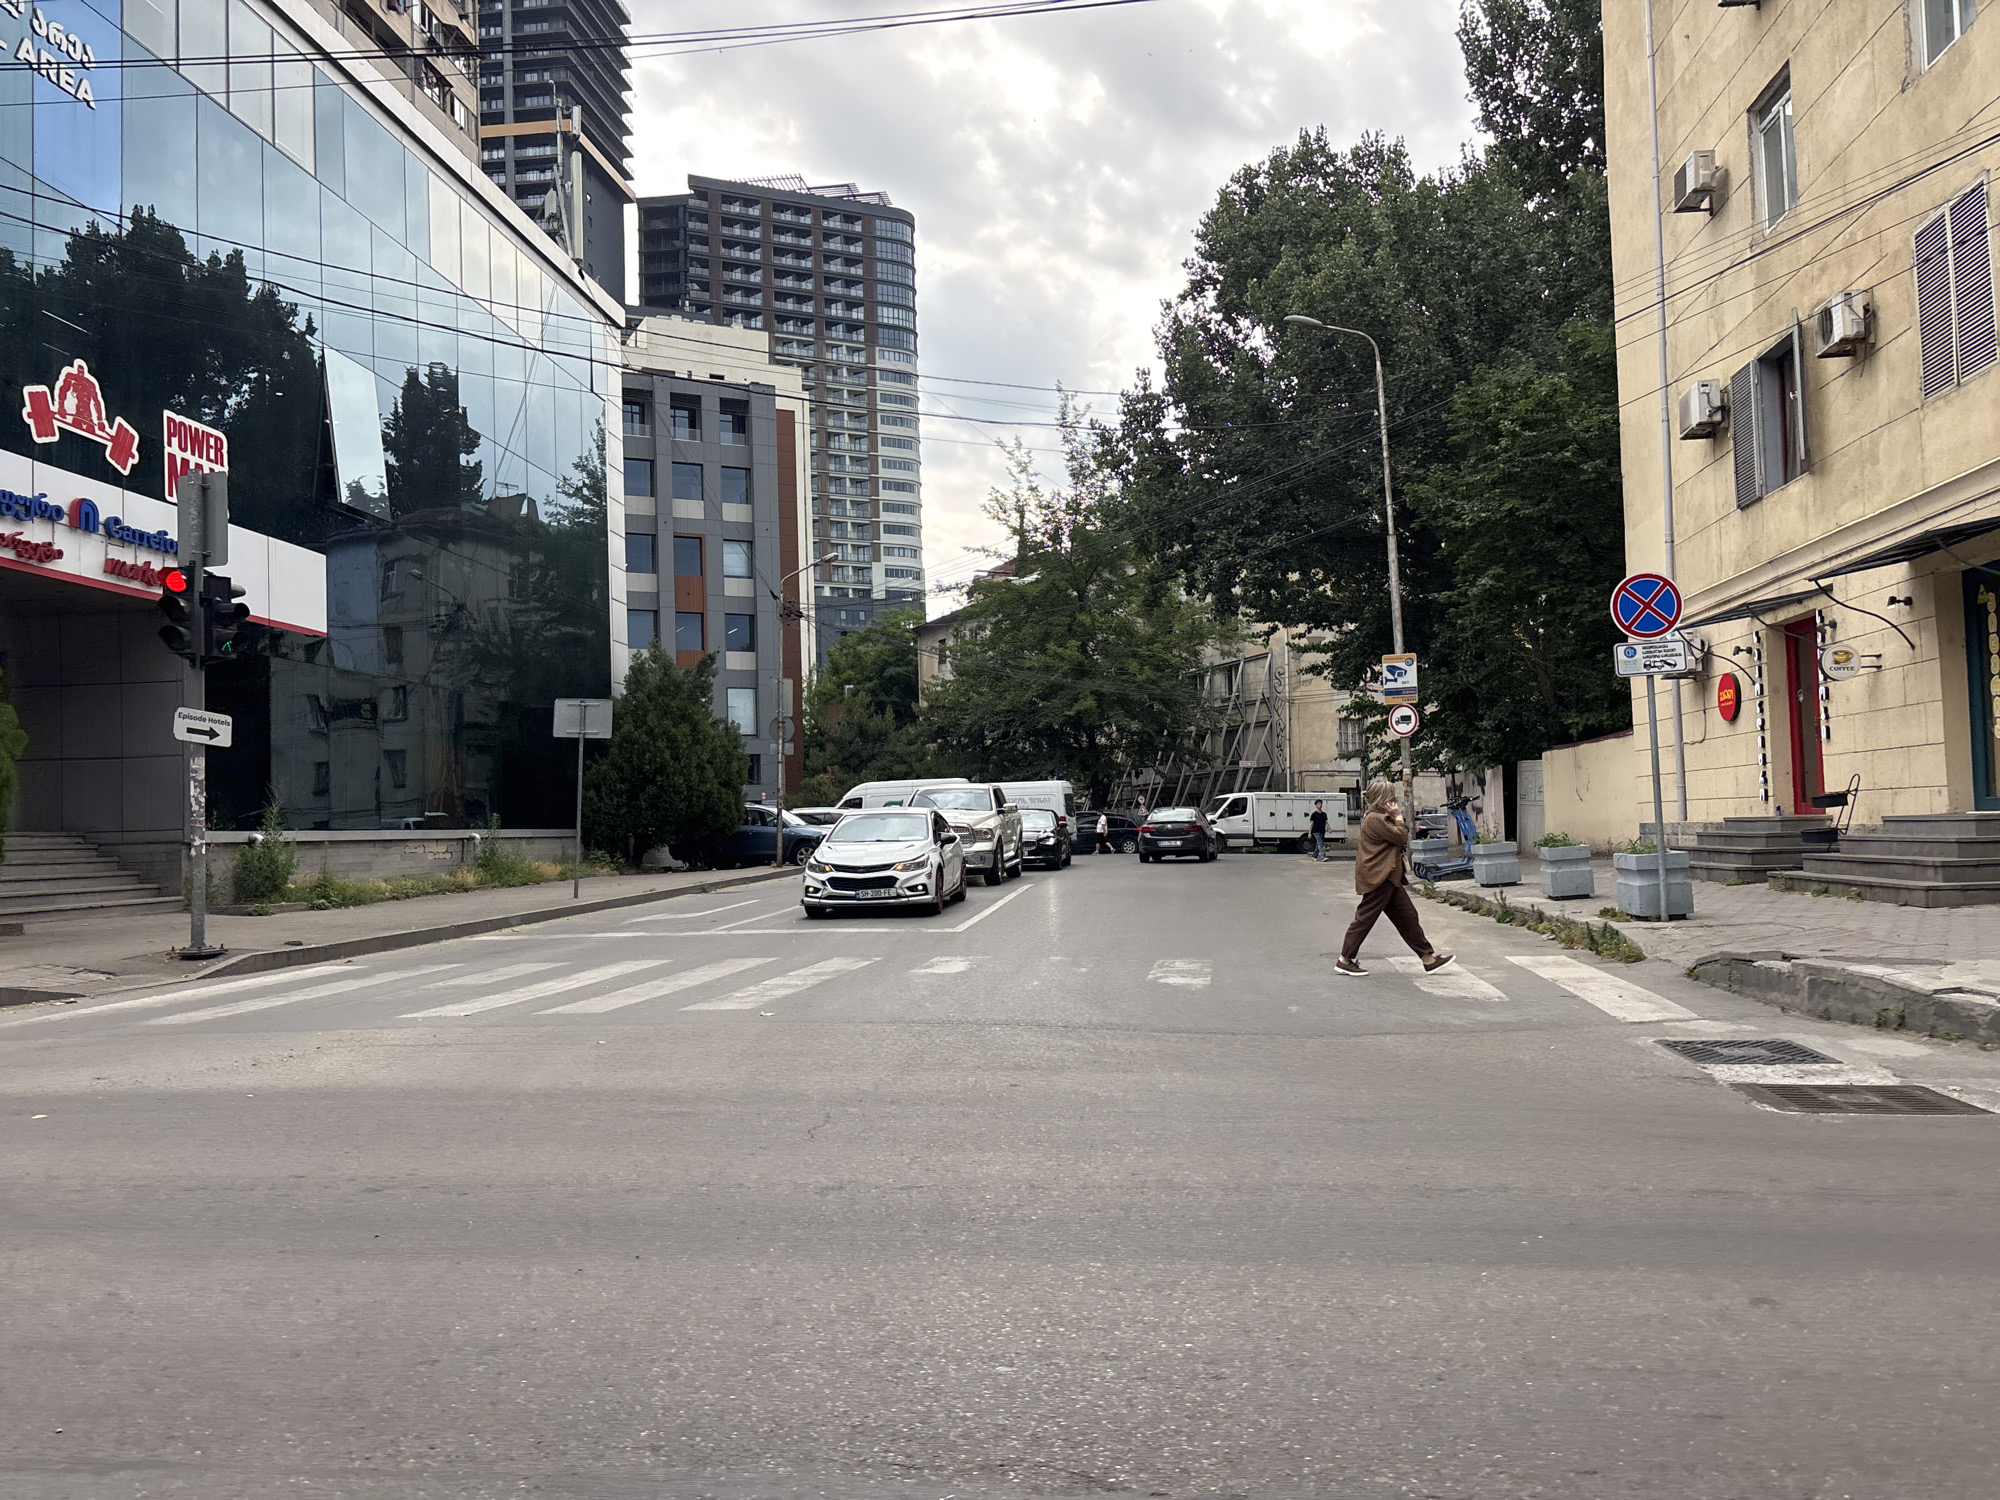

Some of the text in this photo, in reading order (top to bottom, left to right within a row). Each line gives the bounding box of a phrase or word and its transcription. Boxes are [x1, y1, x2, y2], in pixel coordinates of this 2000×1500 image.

[14, 37, 96, 110] AREA
[166, 415, 225, 468] POWER
[104, 516, 178, 554] Carrefo
[178, 712, 231, 727] Episode Hotels
